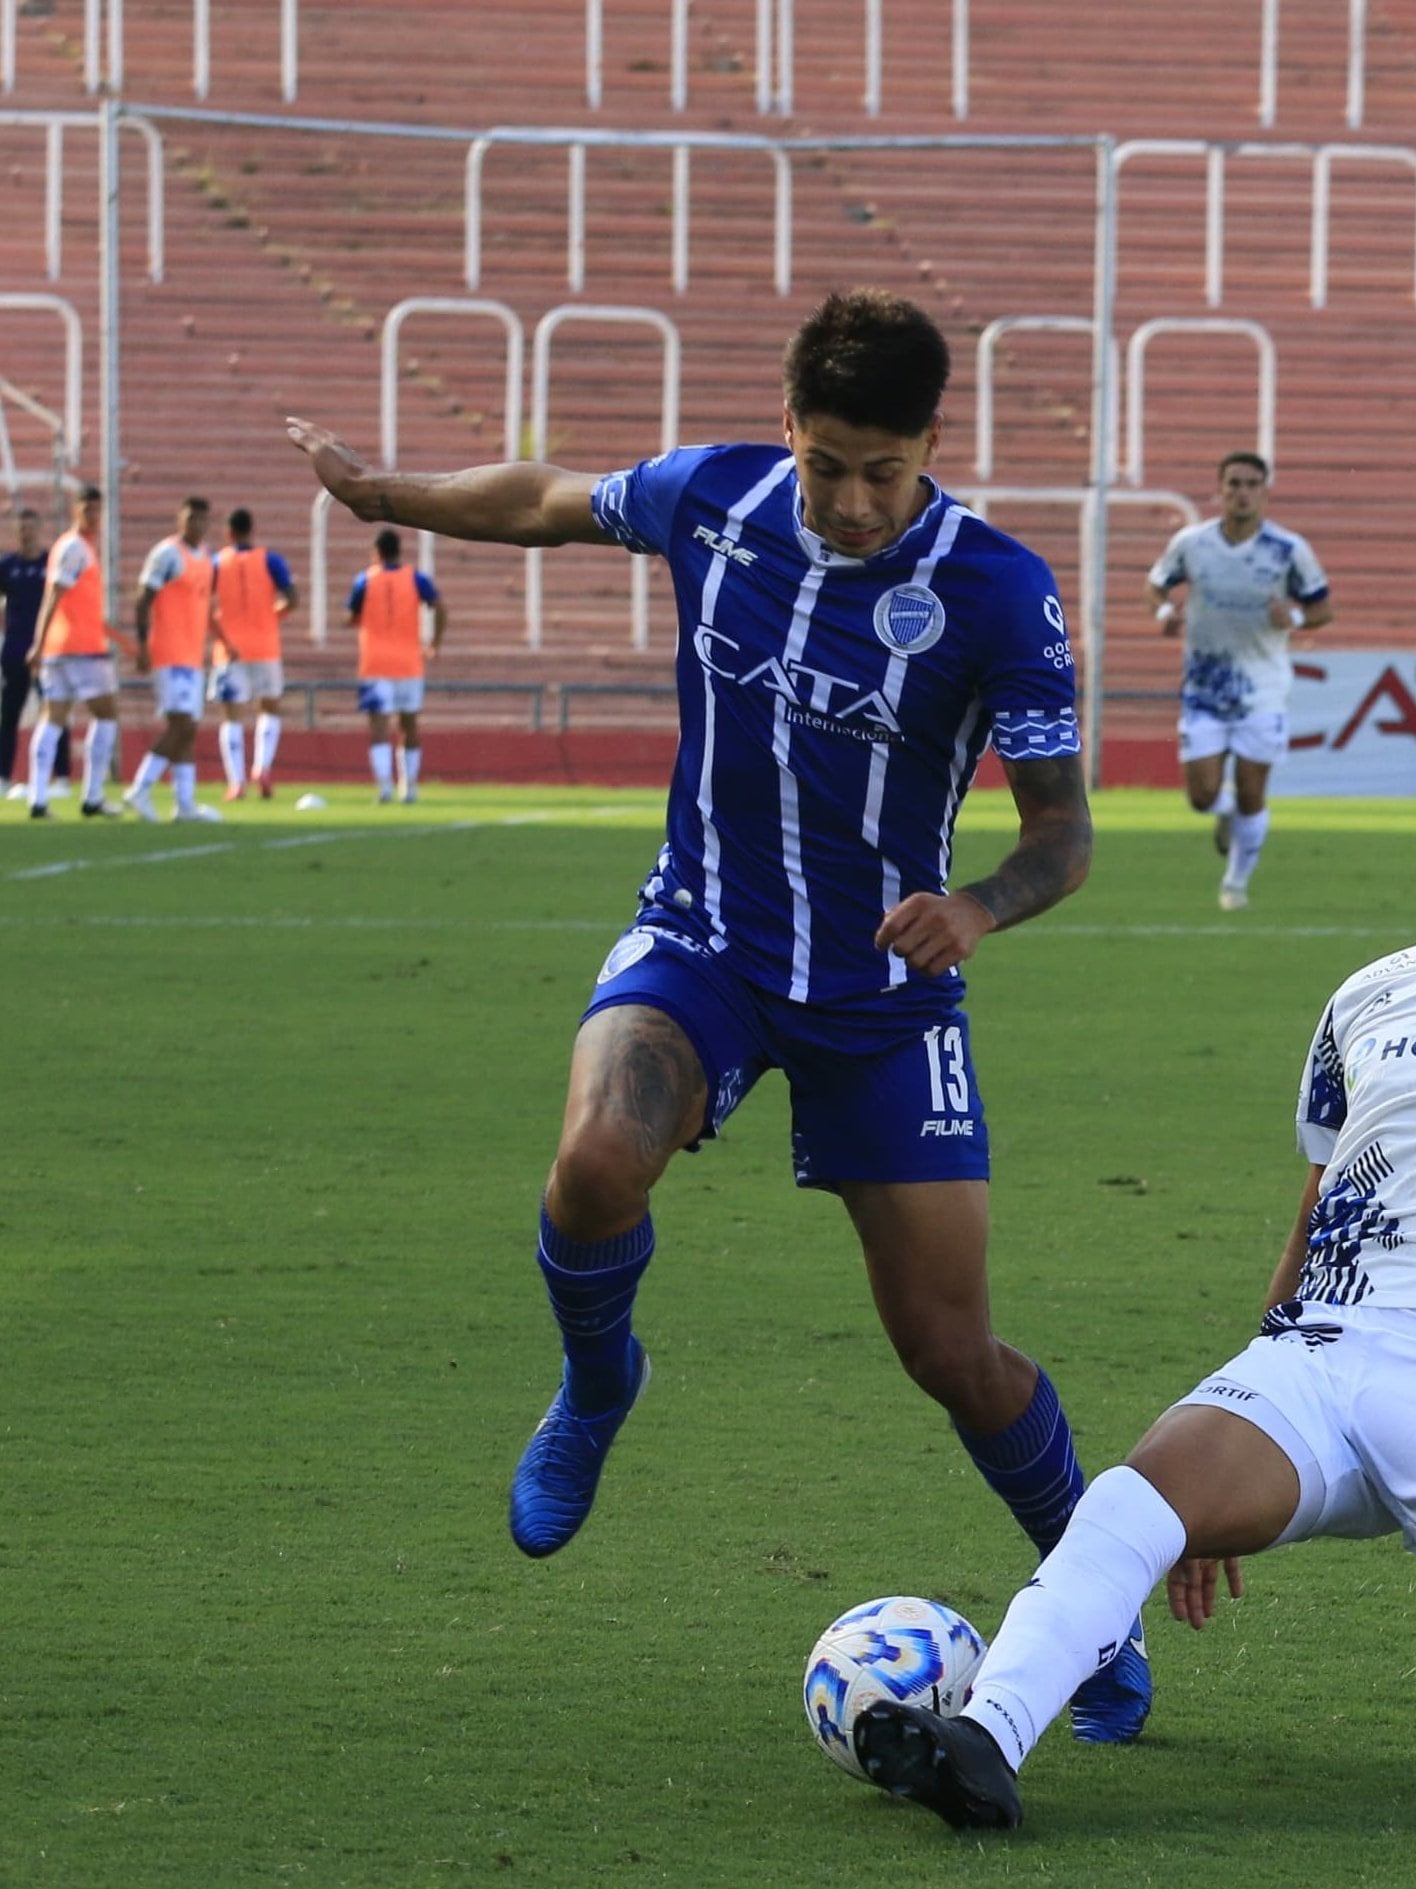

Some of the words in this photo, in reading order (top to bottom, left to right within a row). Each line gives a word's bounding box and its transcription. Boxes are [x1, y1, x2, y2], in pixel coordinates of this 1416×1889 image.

[693, 525, 759, 567] FIUME
[694, 624, 900, 733] CATA
[786, 706, 905, 742] Internacionl
[924, 1026, 969, 1113] 13
[920, 1119, 974, 1137] FIUME
